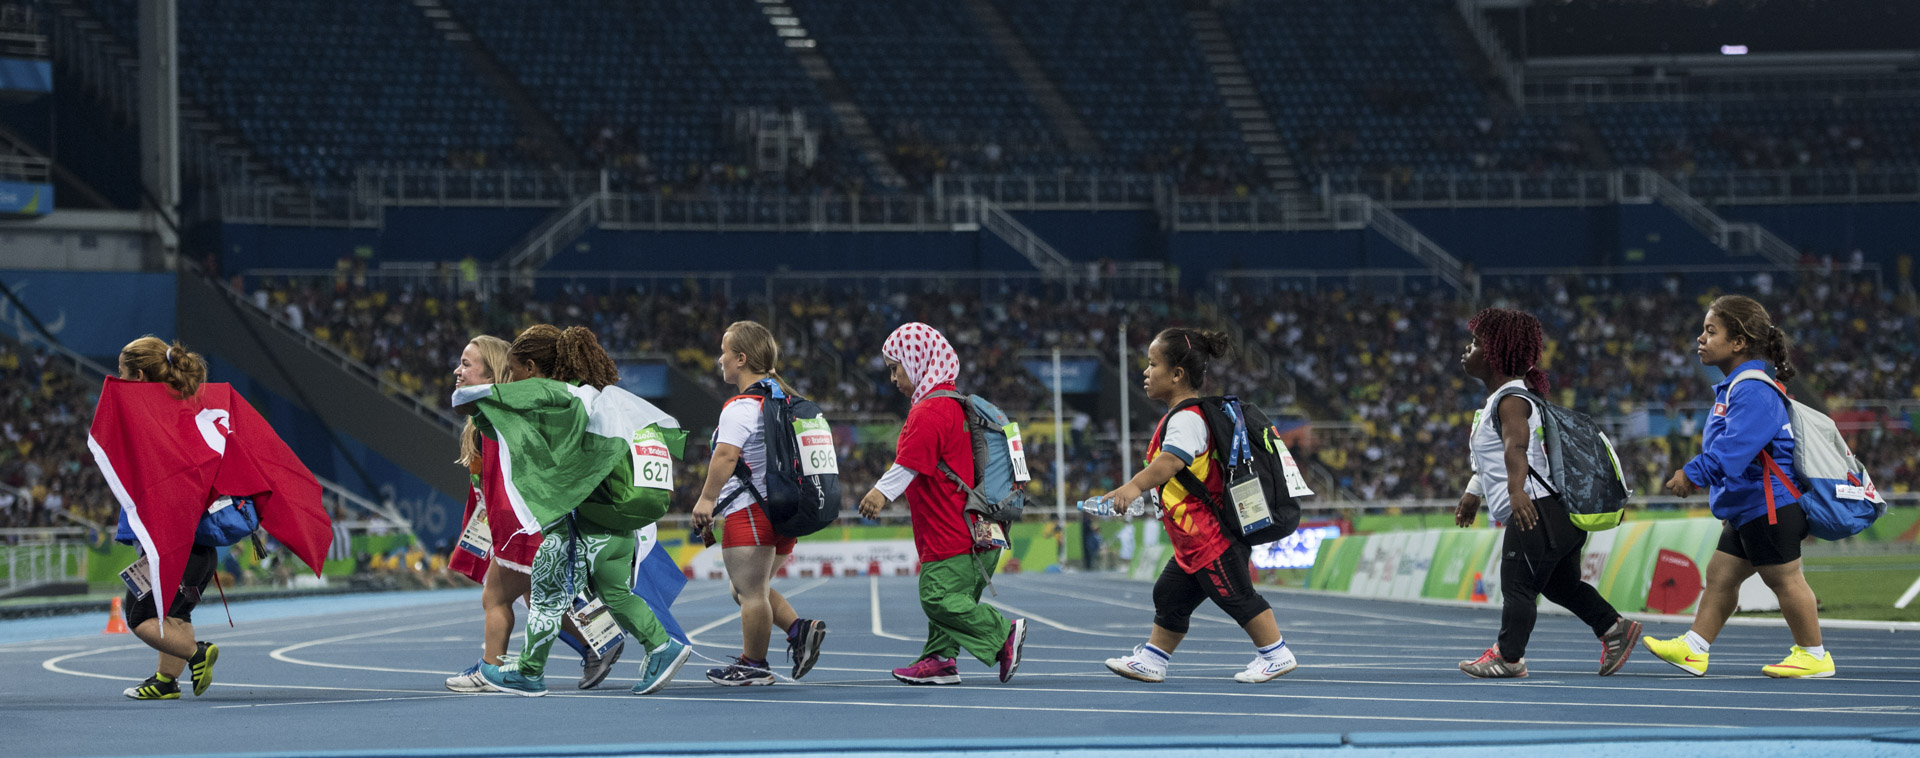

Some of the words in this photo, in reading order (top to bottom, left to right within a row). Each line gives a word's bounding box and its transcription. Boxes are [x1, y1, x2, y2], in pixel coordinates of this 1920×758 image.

[810, 449, 836, 469] 696
[643, 461, 669, 483] 627
[811, 474, 825, 510] SKA
